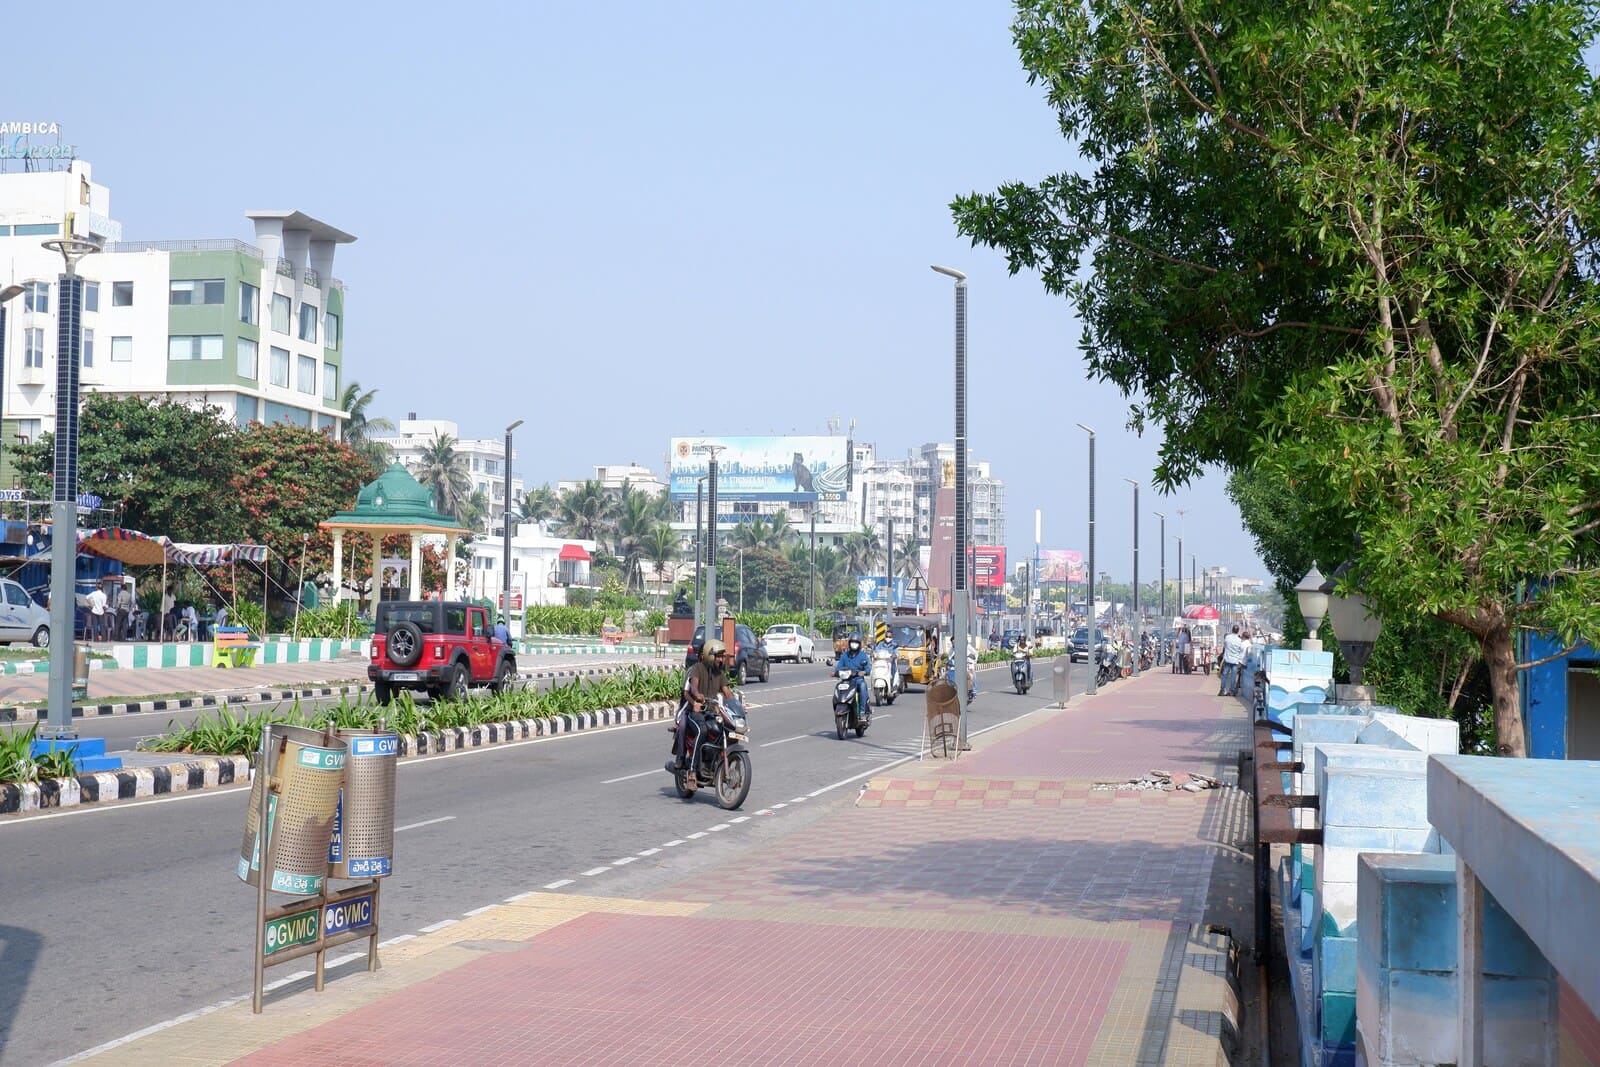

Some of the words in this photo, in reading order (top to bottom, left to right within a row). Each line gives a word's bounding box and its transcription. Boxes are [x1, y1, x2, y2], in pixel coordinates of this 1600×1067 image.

[0, 122, 58, 134] AMBICA
[335, 901, 370, 928] GVMC
[278, 916, 316, 945] GVMC
